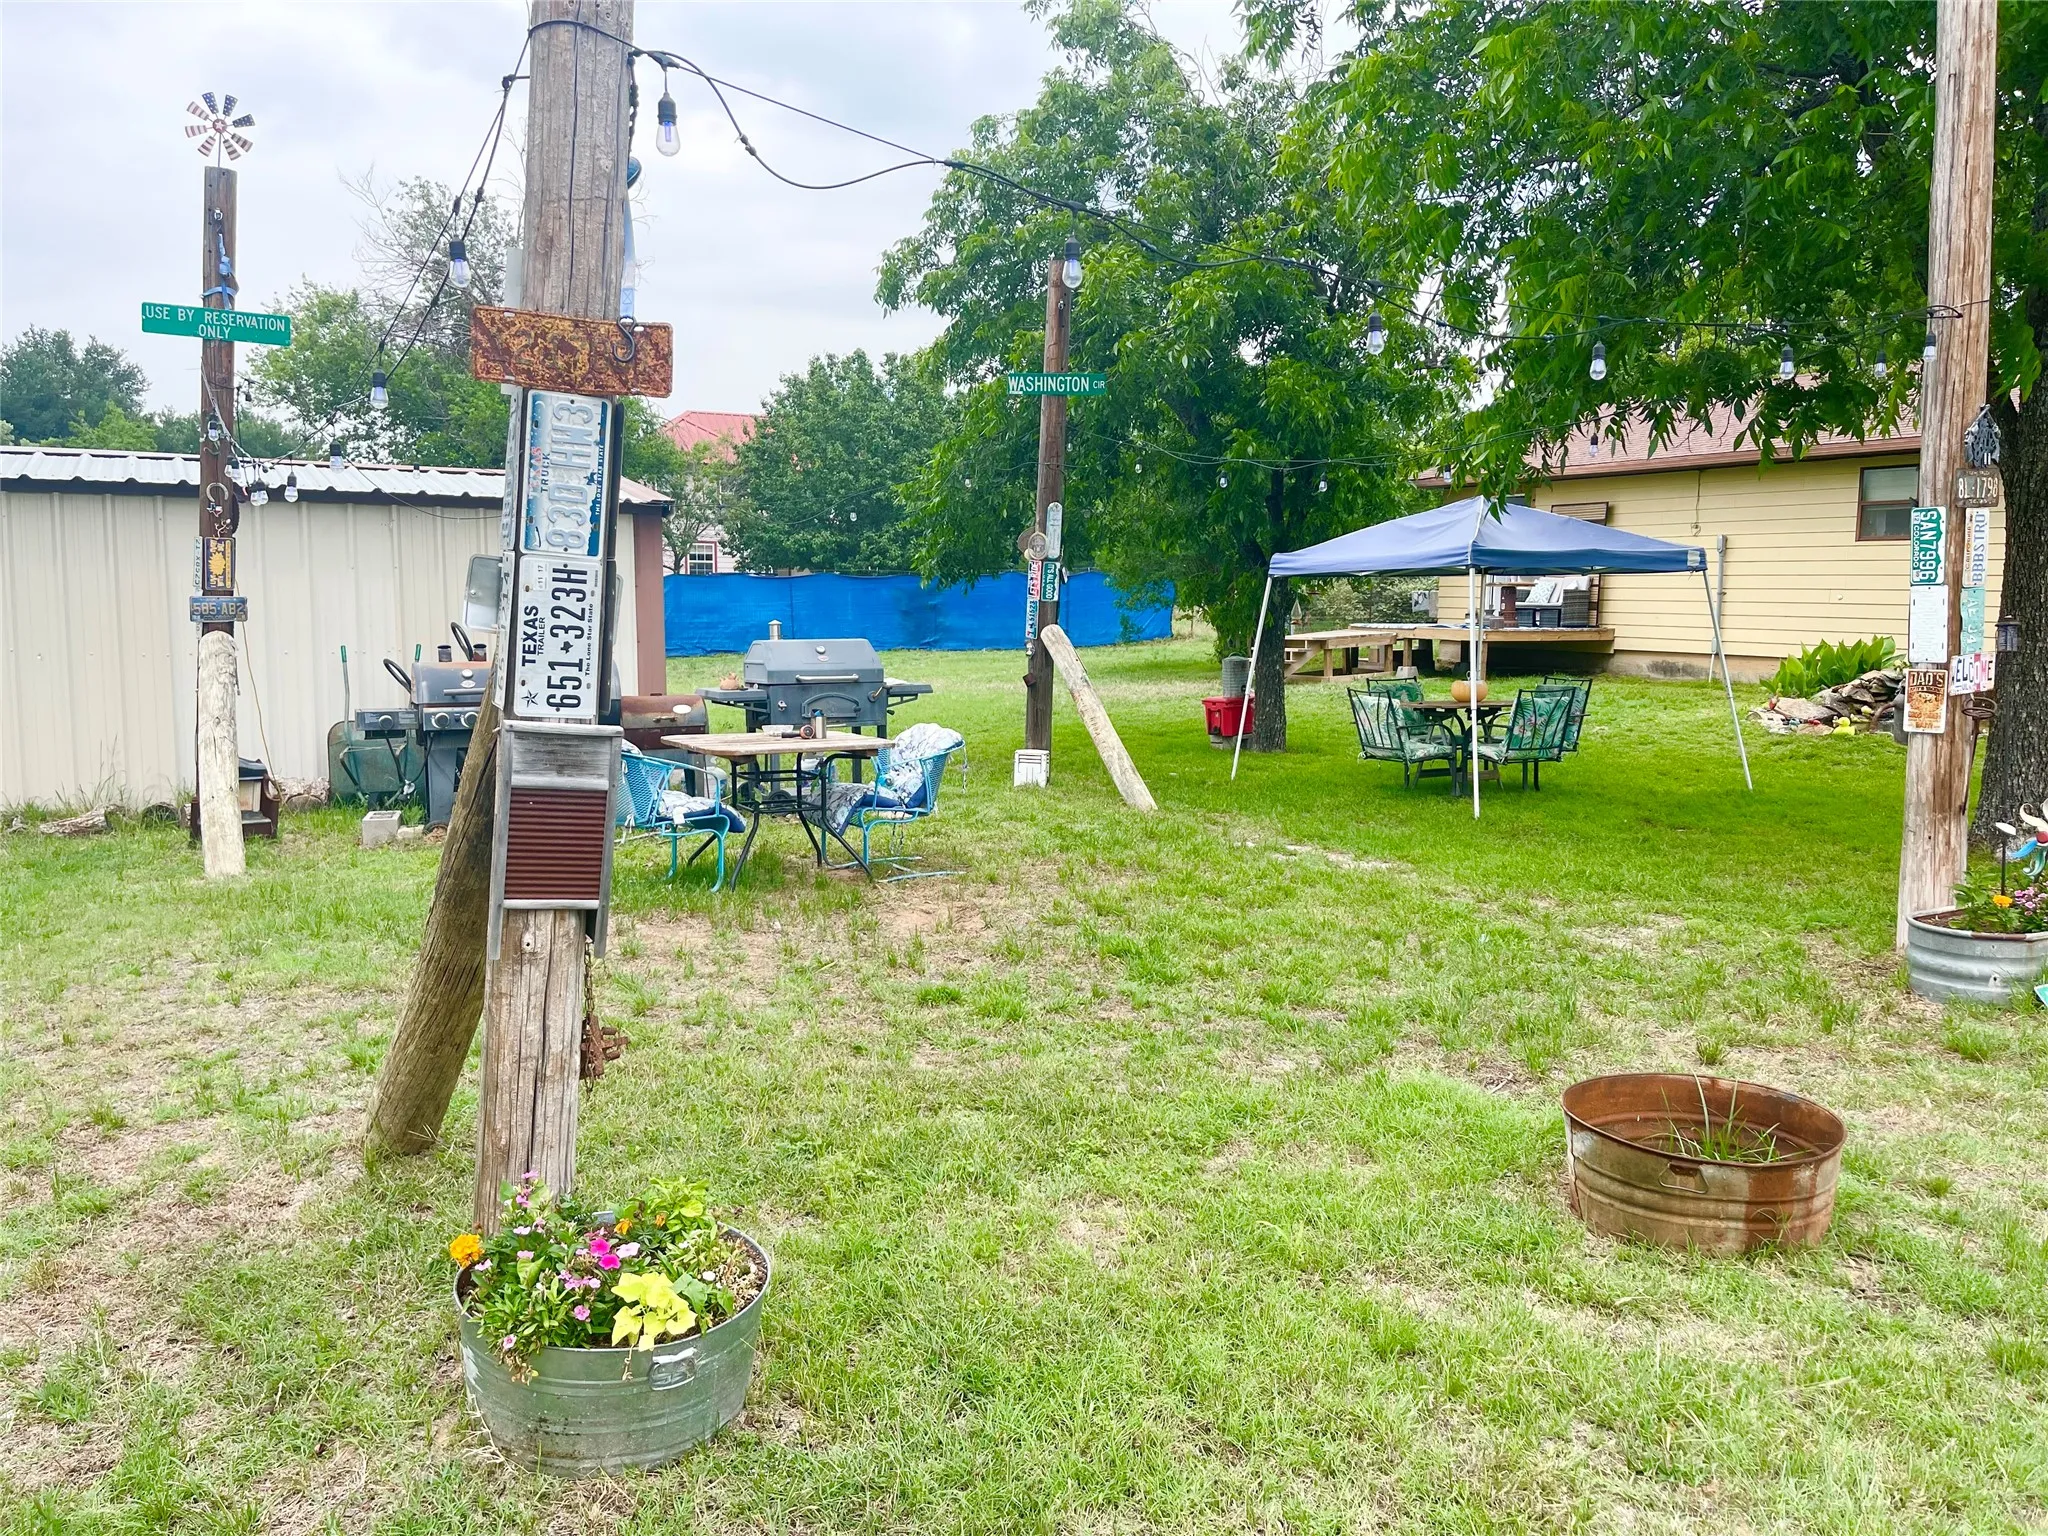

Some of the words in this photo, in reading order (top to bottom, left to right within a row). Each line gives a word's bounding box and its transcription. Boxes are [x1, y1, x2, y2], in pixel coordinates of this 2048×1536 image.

[145, 305, 171, 320] USE
[177, 308, 195, 322] BY
[204, 311, 285, 332] RESERVATION
[198, 324, 231, 339] ONLY
[1008, 376, 1090, 392] WASHINGTON
[1092, 380, 1106, 389] CIR
[541, 453, 551, 494] TRUCK
[1919, 510, 1938, 580] SAN7996
[549, 567, 588, 640] 323H
[521, 605, 539, 667] TEXAS
[537, 617, 546, 656] TRAILER
[546, 658, 584, 708] 651
[1909, 672, 1945, 688] DAD'S
